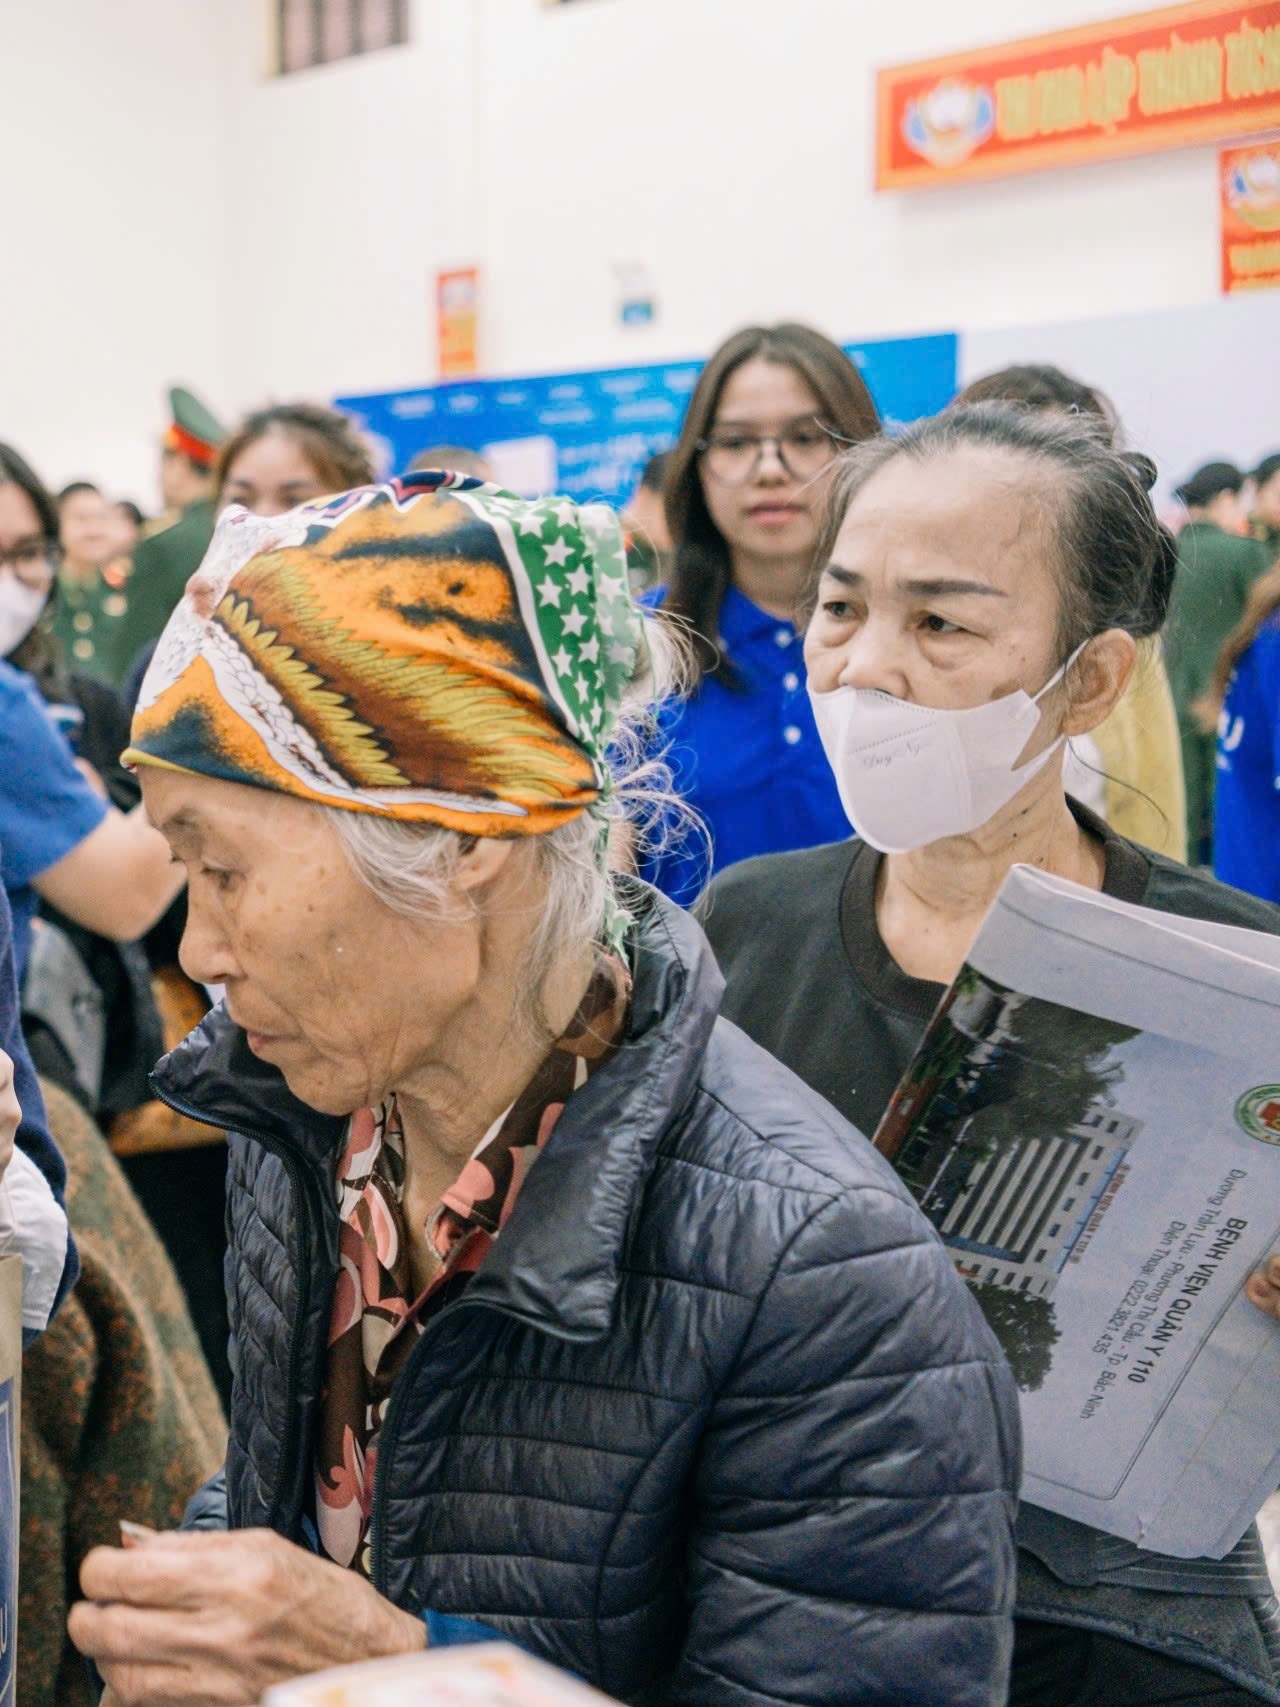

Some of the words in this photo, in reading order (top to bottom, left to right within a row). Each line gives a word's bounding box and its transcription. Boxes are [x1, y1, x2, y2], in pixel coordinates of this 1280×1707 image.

[1206, 1168, 1247, 1205] Đường
[1204, 1217, 1248, 1260] BỆNH
[1144, 1261, 1185, 1302] Phường
[1179, 1263, 1218, 1296] VIỆN
[1151, 1298, 1192, 1342] QUÂN
[1144, 1346, 1165, 1357] Y
[1093, 1370, 1117, 1392] Bắc
[1127, 1359, 1154, 1383] 110
[1079, 1393, 1104, 1418] Ninh
